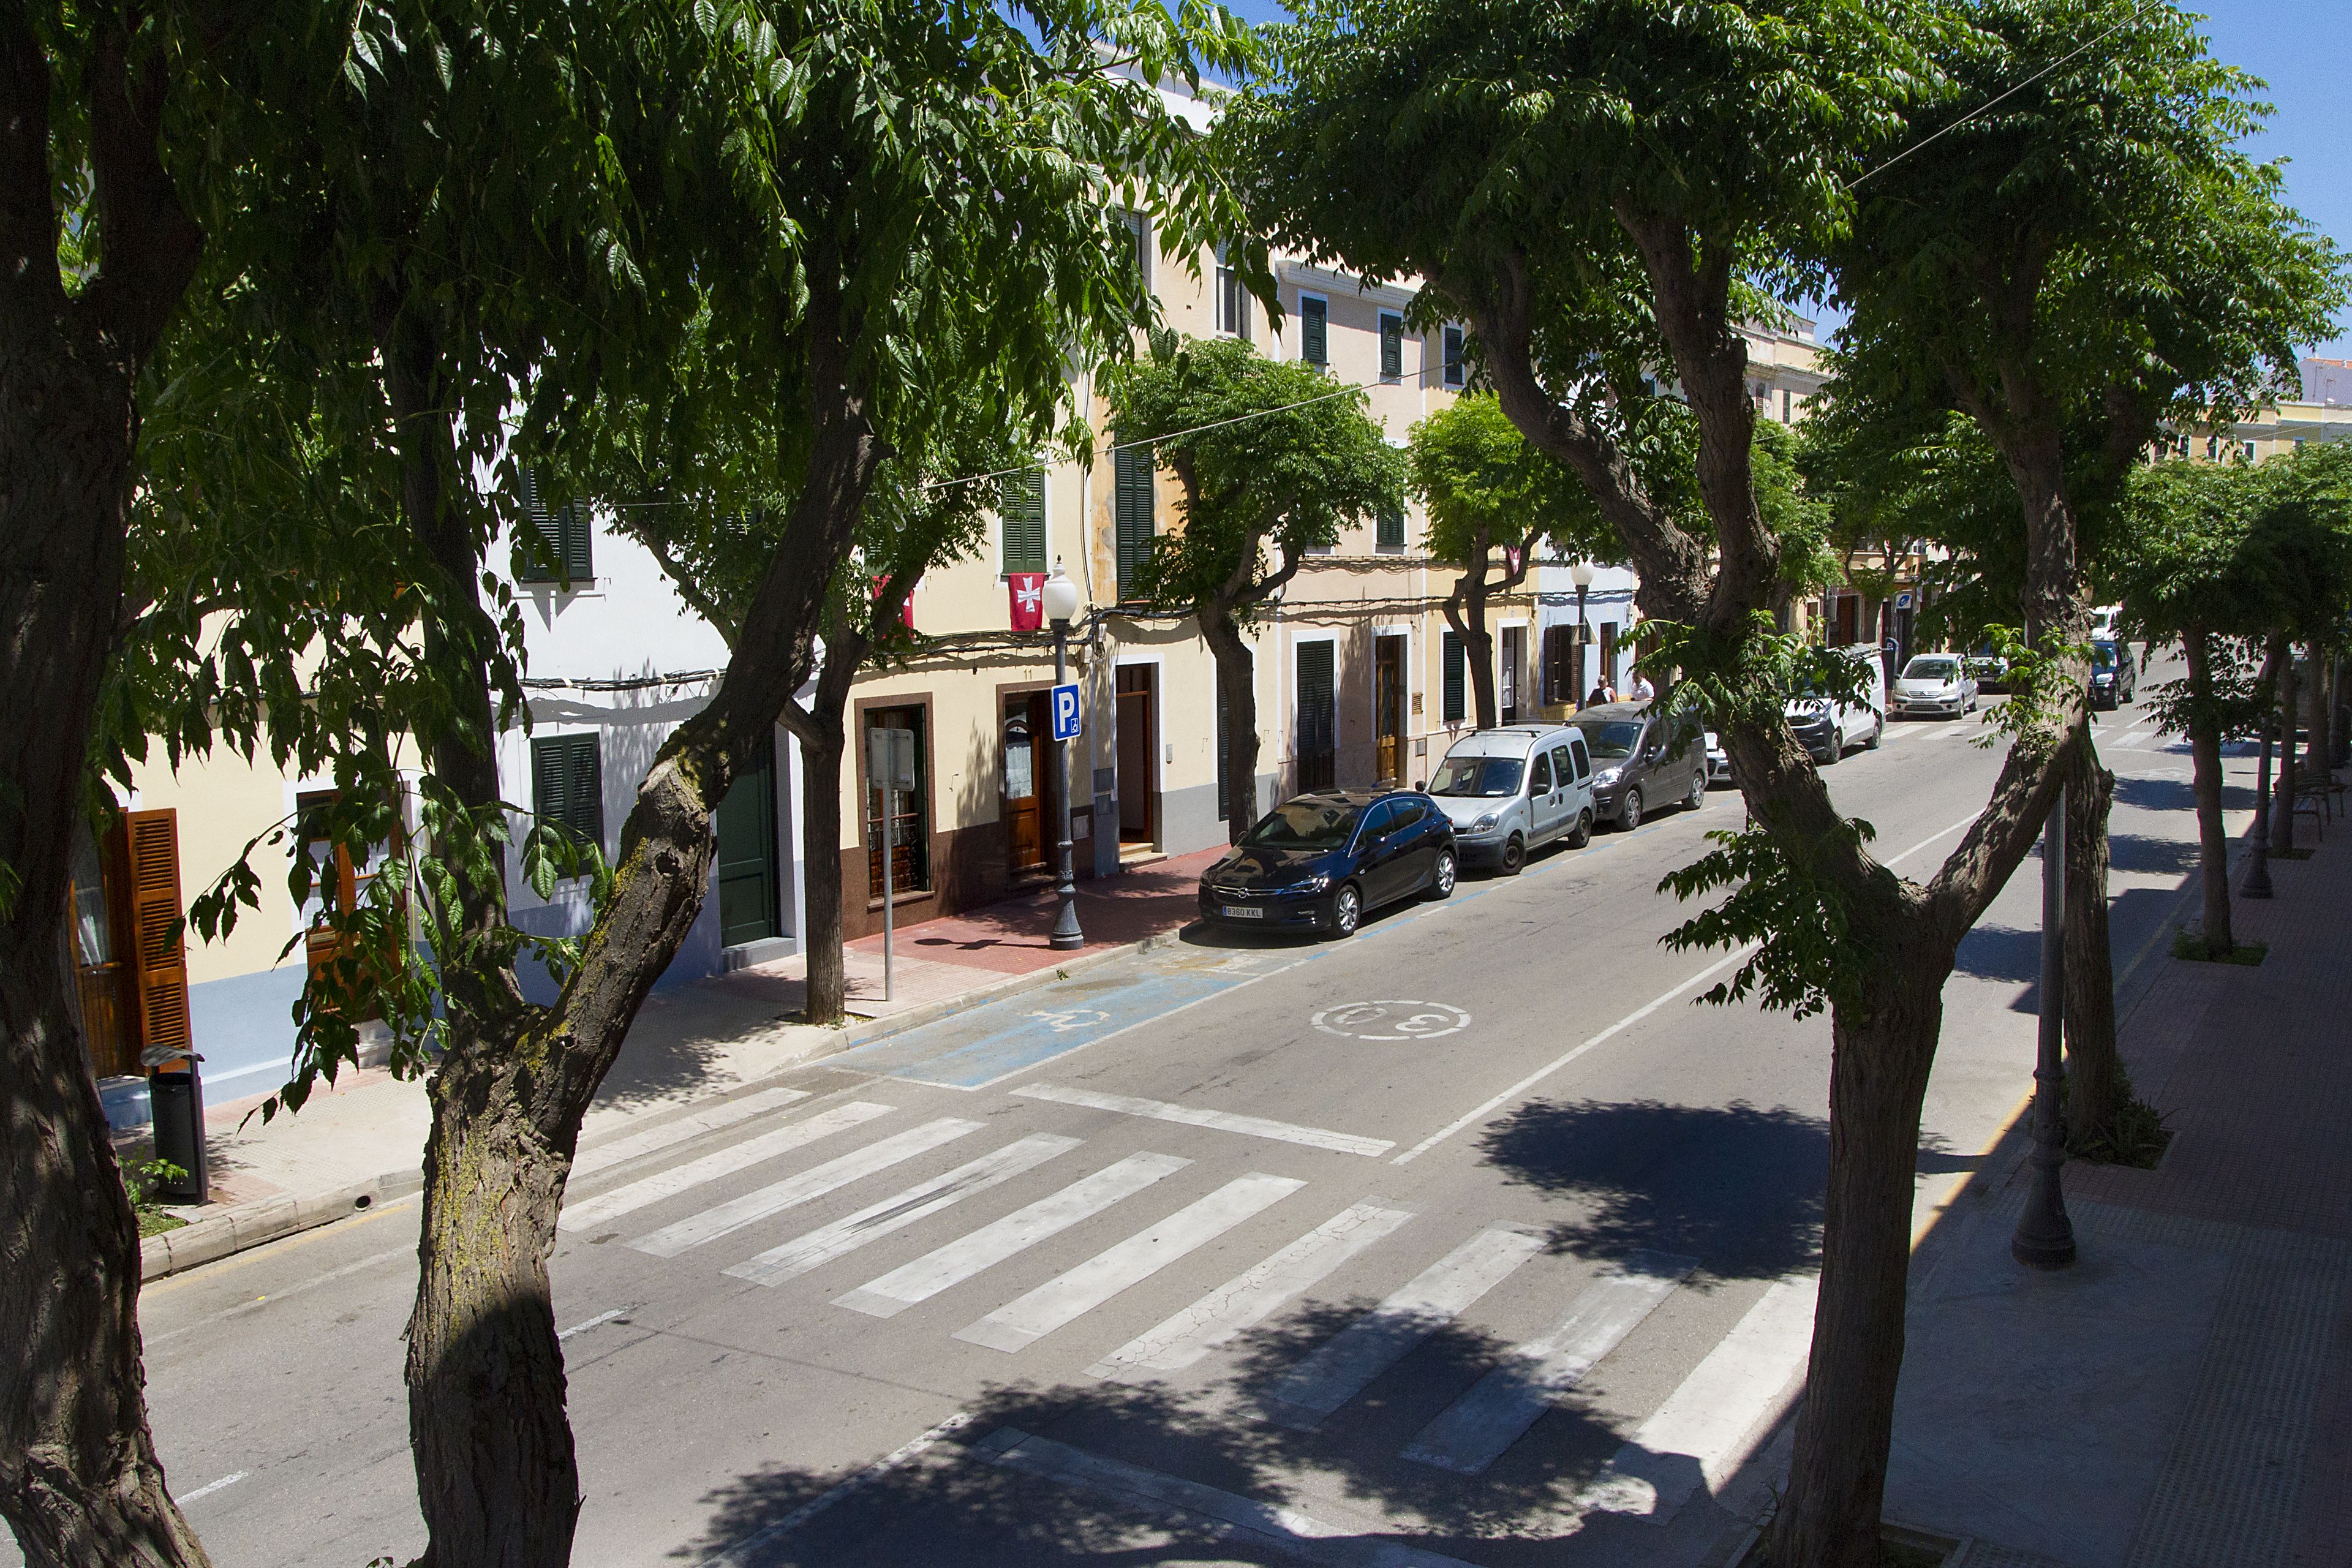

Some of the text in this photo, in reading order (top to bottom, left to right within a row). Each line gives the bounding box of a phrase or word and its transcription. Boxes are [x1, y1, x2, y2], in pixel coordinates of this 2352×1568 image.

[1023, 667, 1033, 681] 11
[1058, 692, 1075, 733] P
[1227, 908, 1245, 916] 8360
